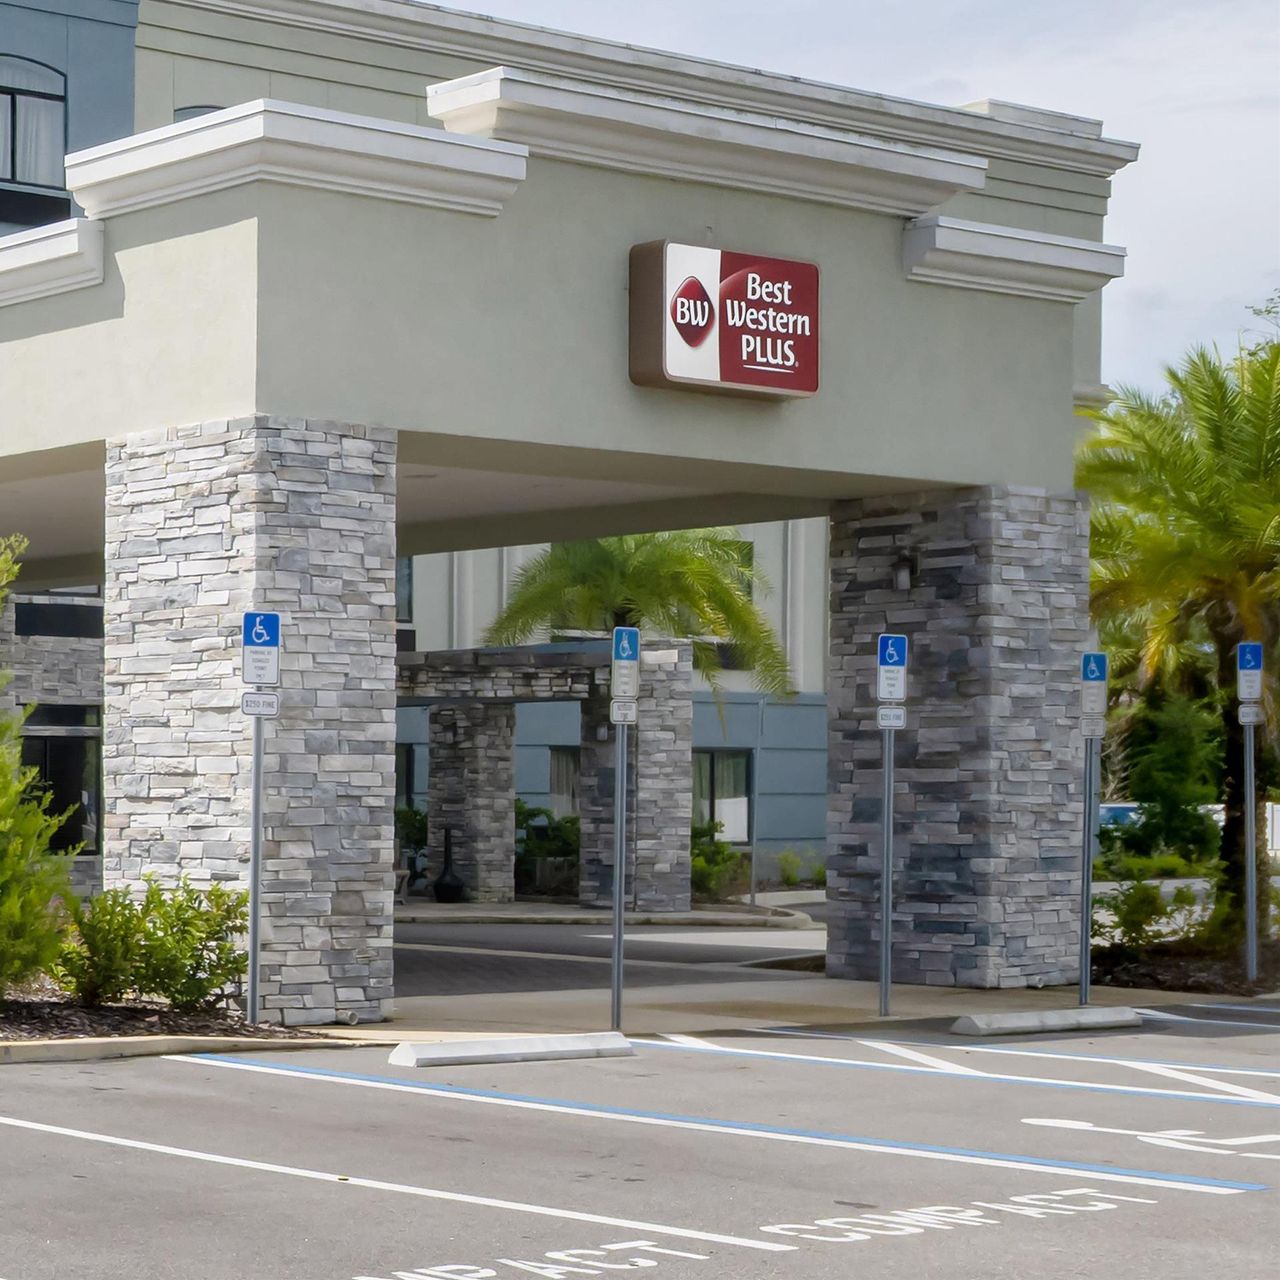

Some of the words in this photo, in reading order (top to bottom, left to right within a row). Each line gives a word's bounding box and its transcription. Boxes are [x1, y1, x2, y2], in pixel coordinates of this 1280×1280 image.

[746, 273, 793, 305] Best
[676, 297, 709, 327] BW
[726, 299, 811, 336] Western
